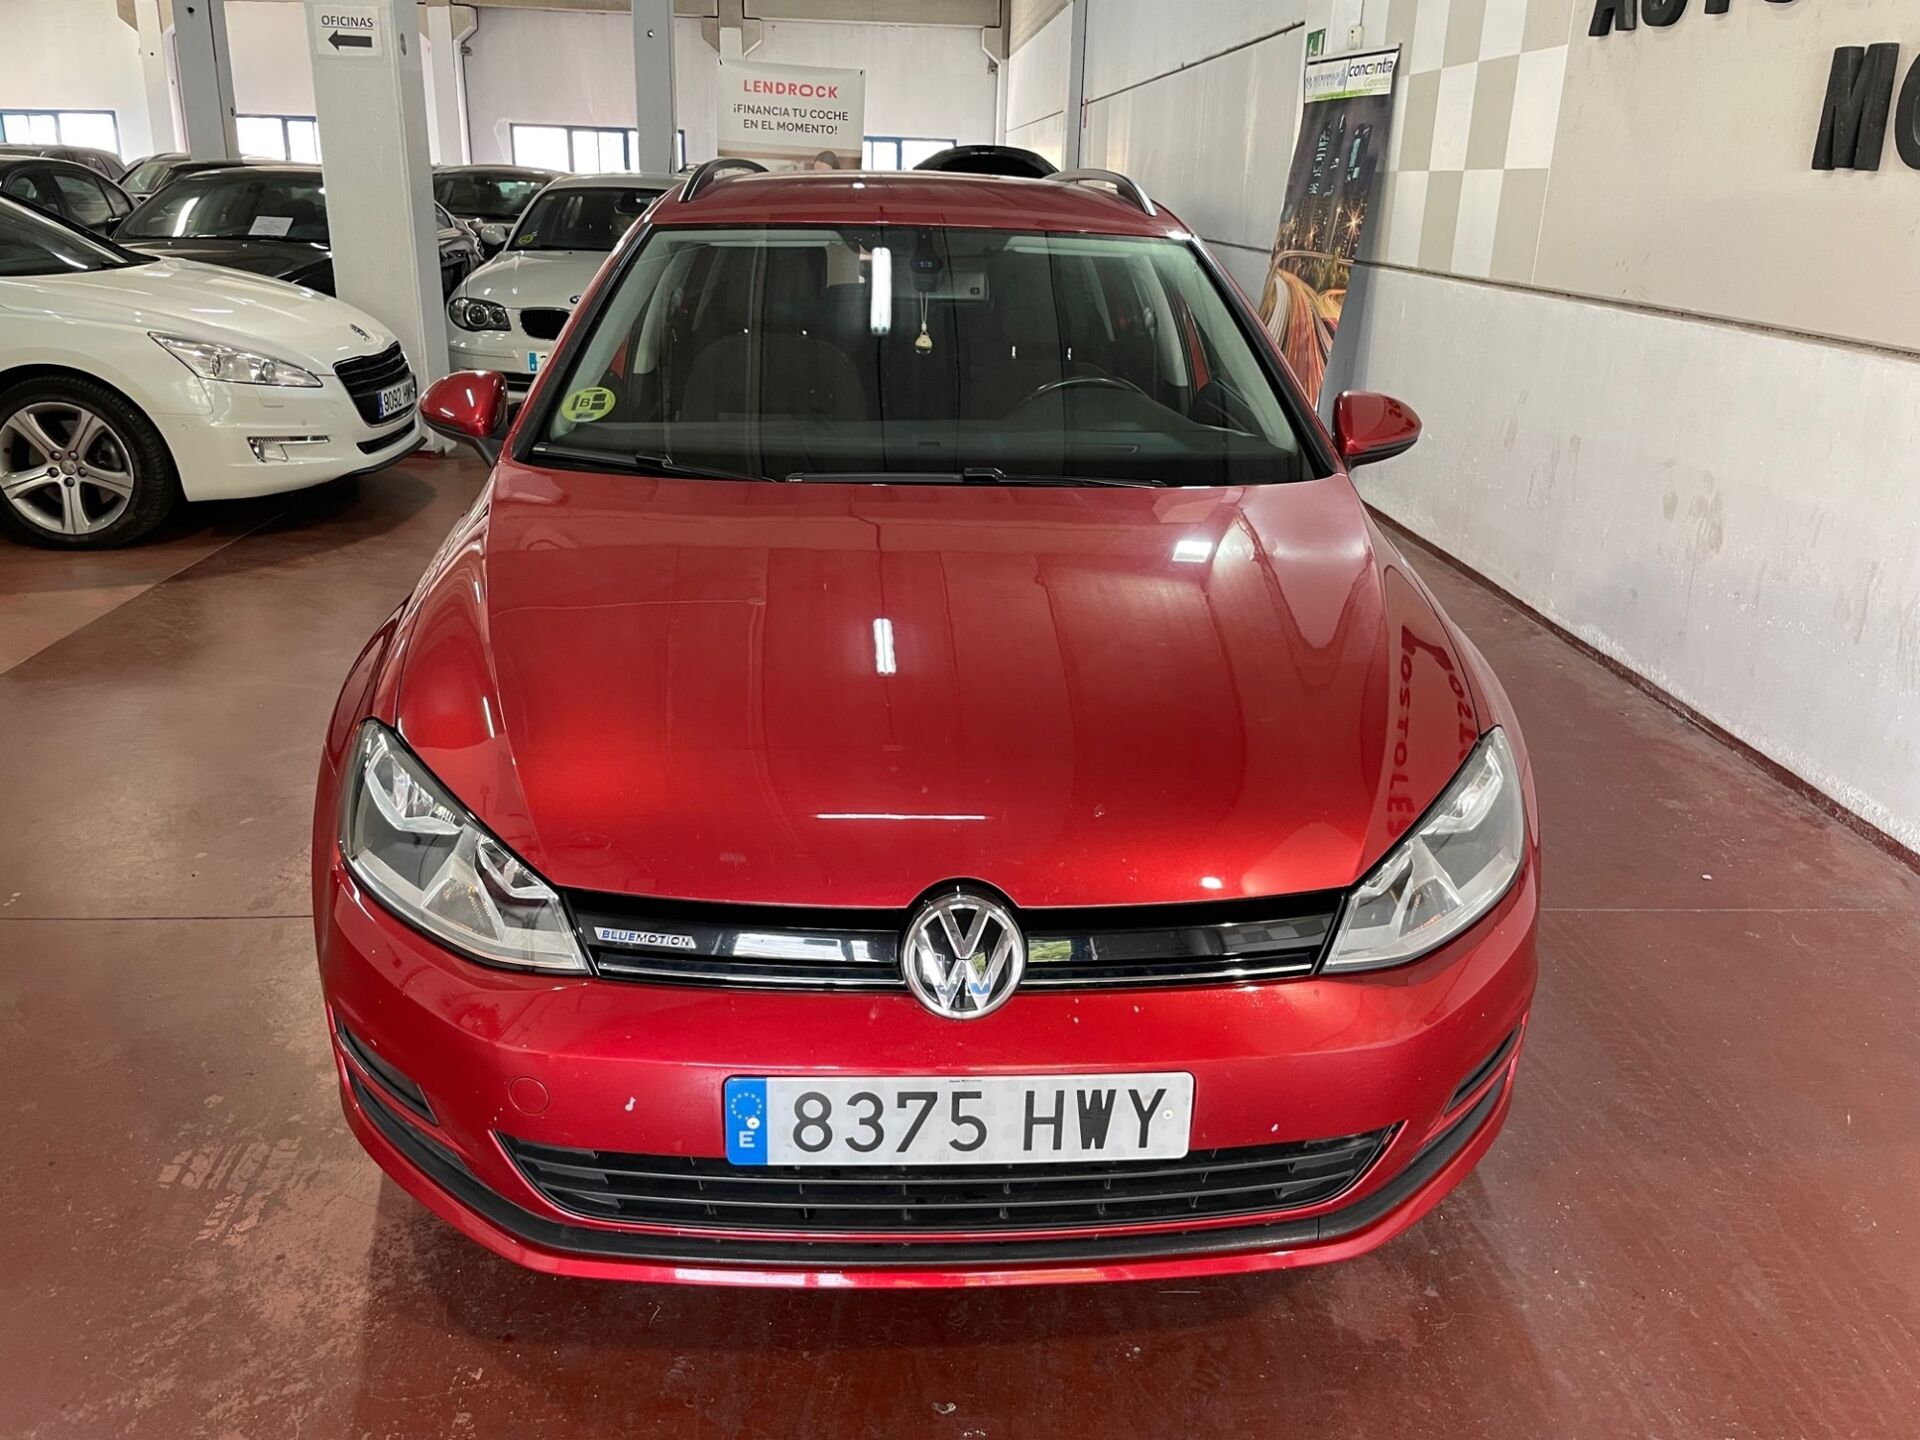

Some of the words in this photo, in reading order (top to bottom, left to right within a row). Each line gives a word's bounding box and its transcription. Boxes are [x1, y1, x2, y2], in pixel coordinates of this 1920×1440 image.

[321, 15, 373, 28] OFICINAS
[744, 80, 838, 98] LENDROCK
[733, 103, 790, 117] ¡FINANCIA
[792, 108, 807, 118] TU
[809, 109, 849, 121] COCHE
[743, 119, 759, 129] EN
[761, 121, 774, 130] EL
[777, 122, 838, 135] MOMENTO!
[602, 930, 690, 946] BLUEMOTION
[792, 1091, 987, 1152] 8375
[1023, 1089, 1167, 1150] HWY
[739, 1131, 755, 1147] E
